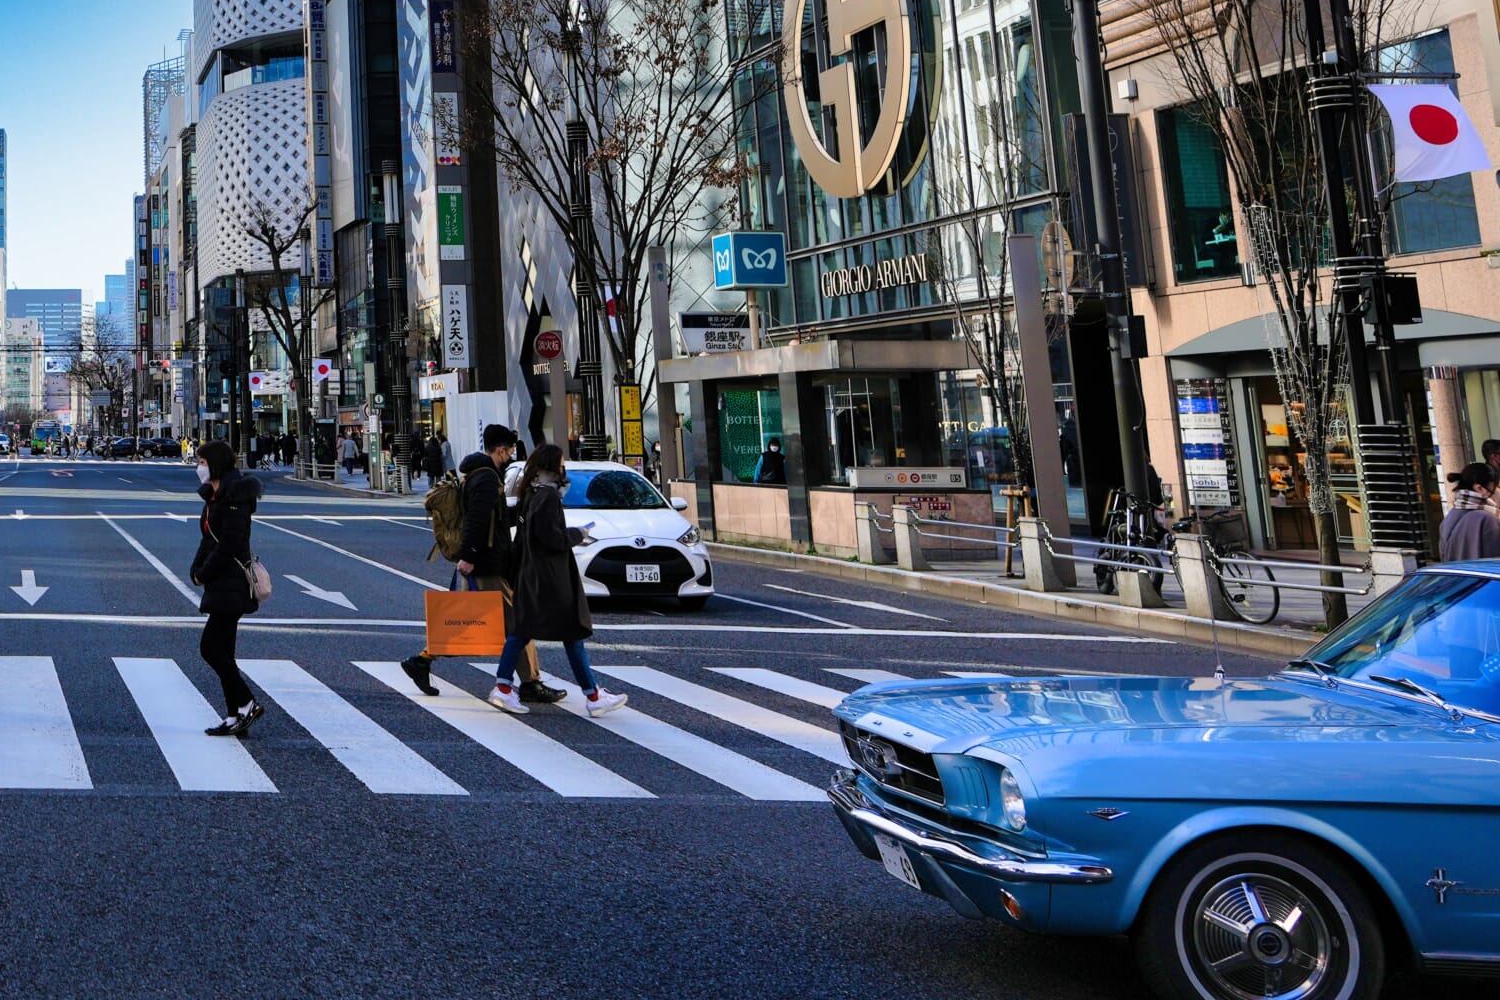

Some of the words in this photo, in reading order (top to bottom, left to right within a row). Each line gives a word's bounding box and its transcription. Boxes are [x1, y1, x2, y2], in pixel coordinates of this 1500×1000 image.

[821, 264, 871, 298] GIORGIO
[875, 253, 928, 289] ARMANI
[449, 309, 464, 341] ハゲ天
[704, 330, 741, 342] 銀座駅
[537, 340, 560, 351] 消火栓
[705, 342, 726, 350] Ginza
[533, 362, 550, 376] BOTTEG
[727, 415, 773, 425] BOTTEGA
[635, 571, 659, 582] 13-60
